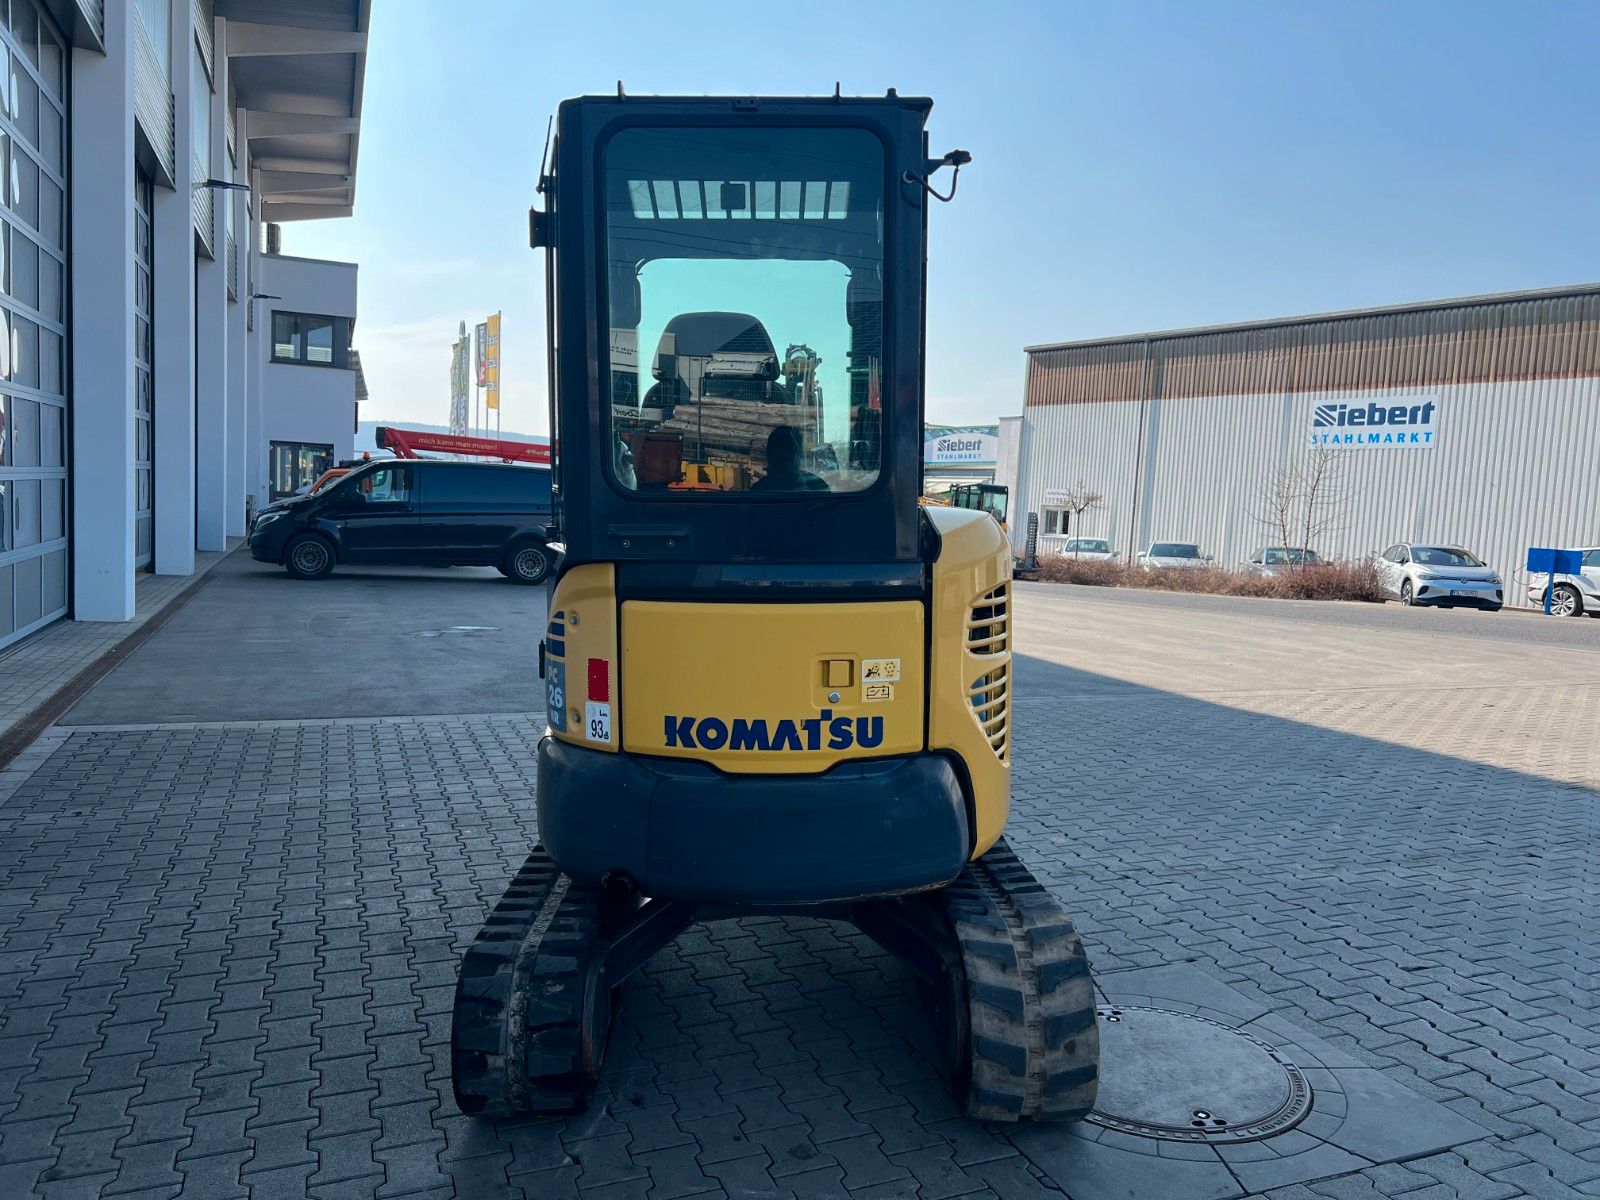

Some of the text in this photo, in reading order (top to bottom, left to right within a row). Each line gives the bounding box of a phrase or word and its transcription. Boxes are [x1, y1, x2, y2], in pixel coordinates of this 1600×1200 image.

[1313, 401, 1435, 427] Siebert
[436, 439, 454, 447] kann
[937, 439, 982, 451] Siebert
[1312, 432, 1433, 445] STAHLMARKT
[549, 685, 563, 708] 26
[591, 718, 604, 739] 93
[664, 709, 884, 751] KOMATSU
